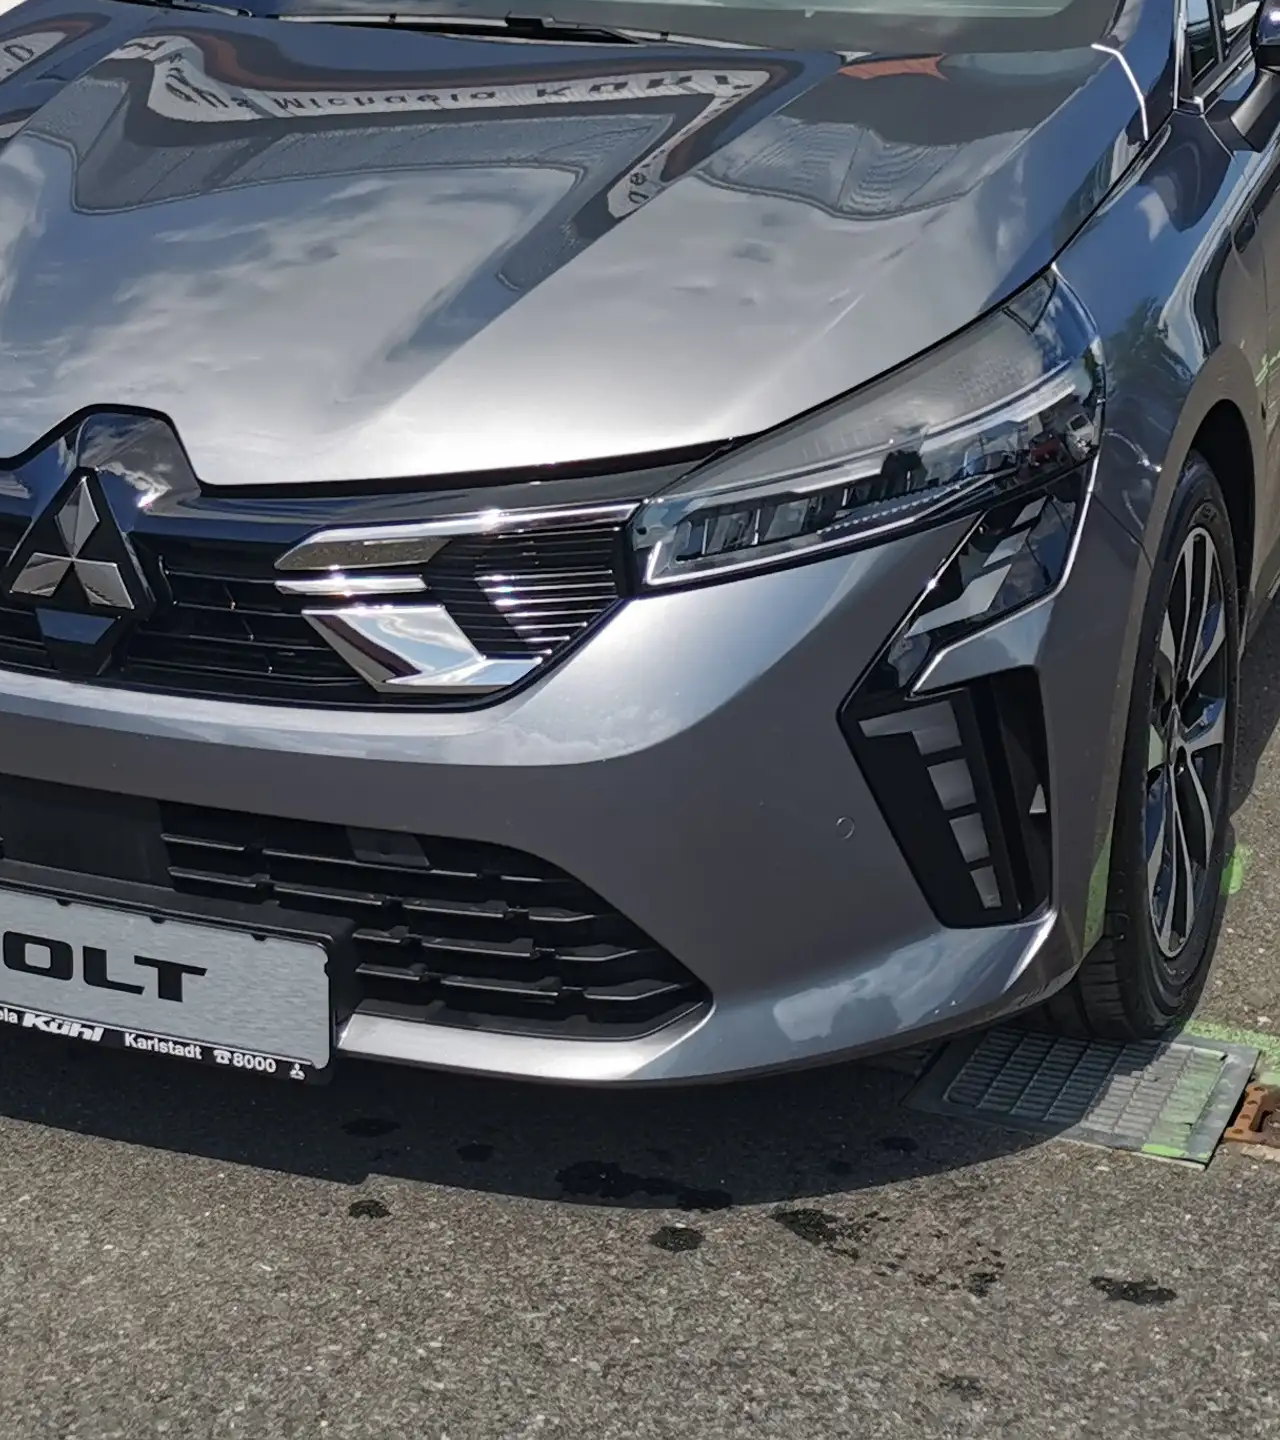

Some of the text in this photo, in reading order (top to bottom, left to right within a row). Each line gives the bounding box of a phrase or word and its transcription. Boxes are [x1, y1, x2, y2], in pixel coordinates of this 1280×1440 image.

[22, 1012, 105, 1043] Kühl
[125, 1031, 203, 1060] Karlstadt
[233, 1052, 277, 1074] 8000
